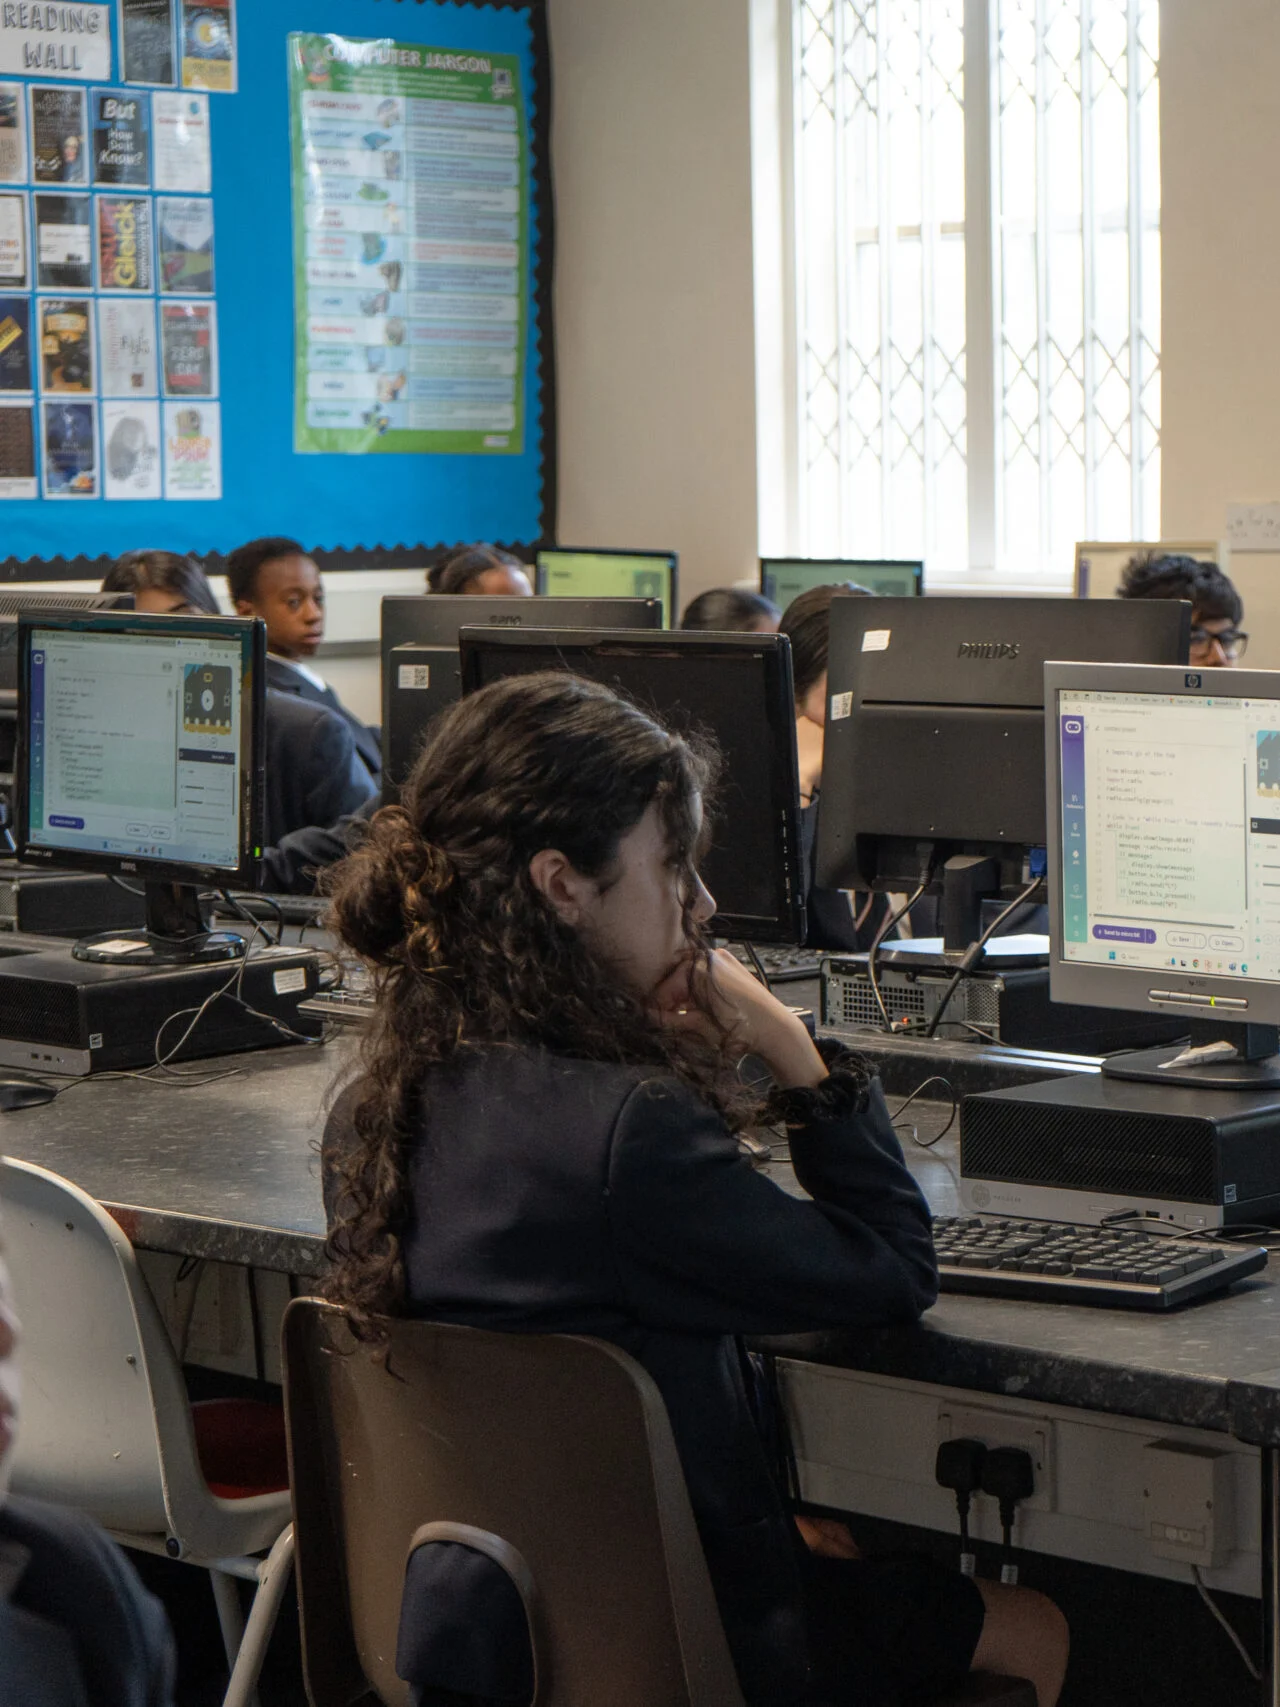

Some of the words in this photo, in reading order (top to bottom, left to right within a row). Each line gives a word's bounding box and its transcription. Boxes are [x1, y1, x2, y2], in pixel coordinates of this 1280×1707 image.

[2, 2, 100, 34] READING
[23, 40, 83, 71] WALL
[324, 43, 422, 69] CPUTER
[425, 52, 492, 74] JARGON
[103, 98, 137, 121] But
[113, 202, 137, 286] Gleick
[957, 643, 1022, 660] PHILIPS
